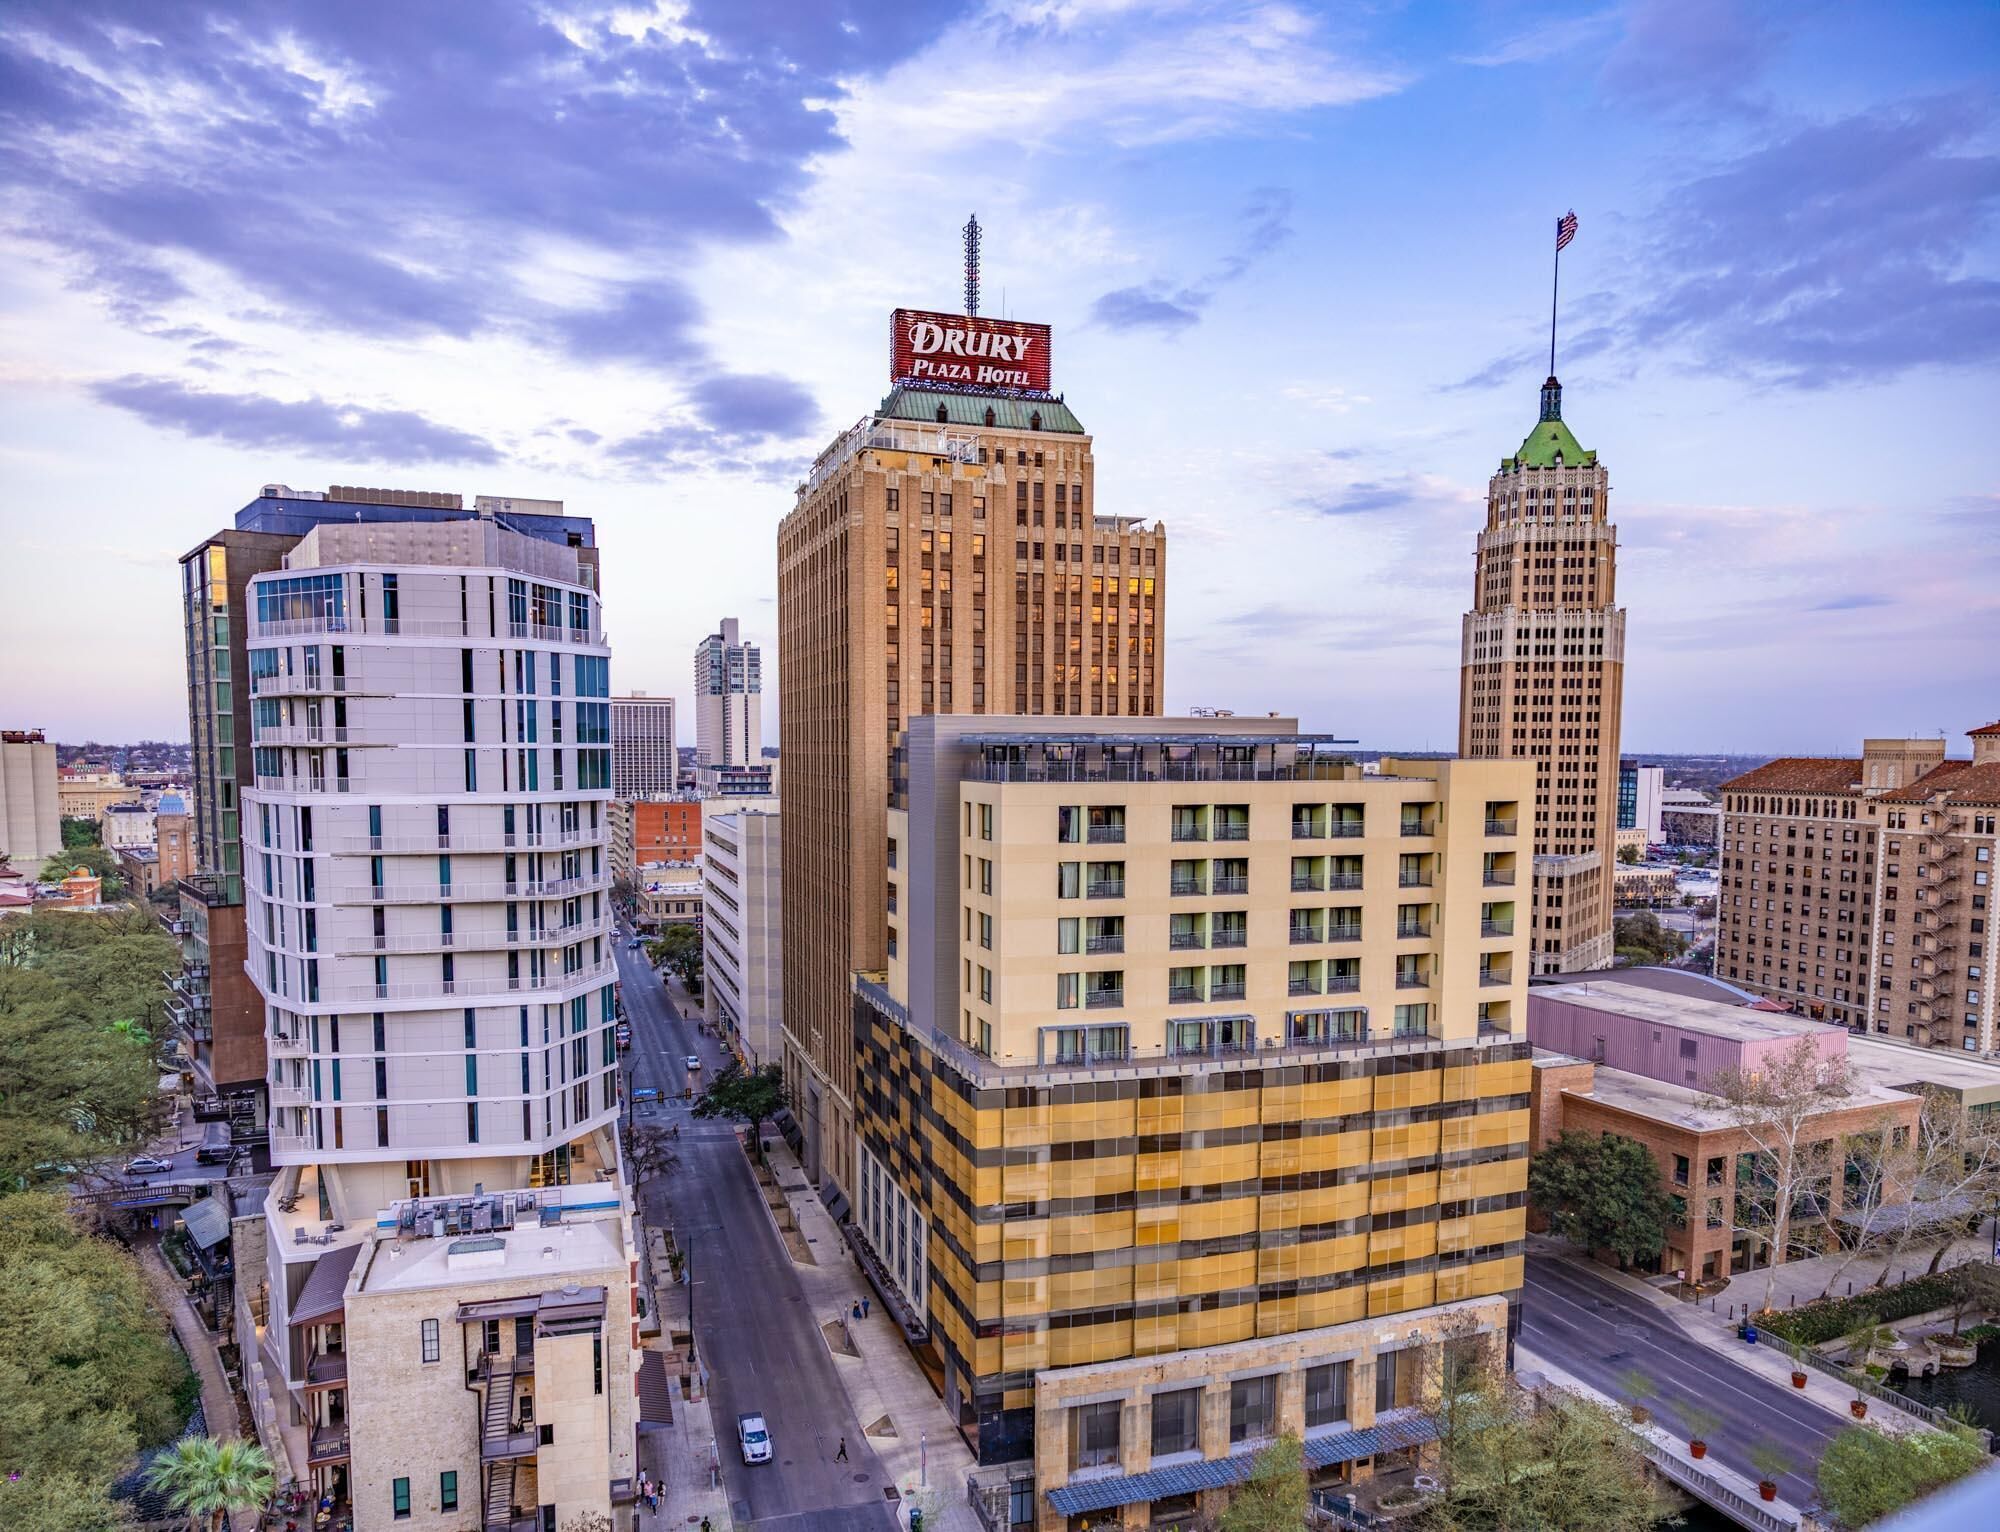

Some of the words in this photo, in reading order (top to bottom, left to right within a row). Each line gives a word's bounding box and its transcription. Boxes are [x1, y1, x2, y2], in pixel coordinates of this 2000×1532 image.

[908, 322, 1032, 361] DRURY
[912, 359, 971, 379] PLAZA
[976, 365, 1030, 385] HOTEL
